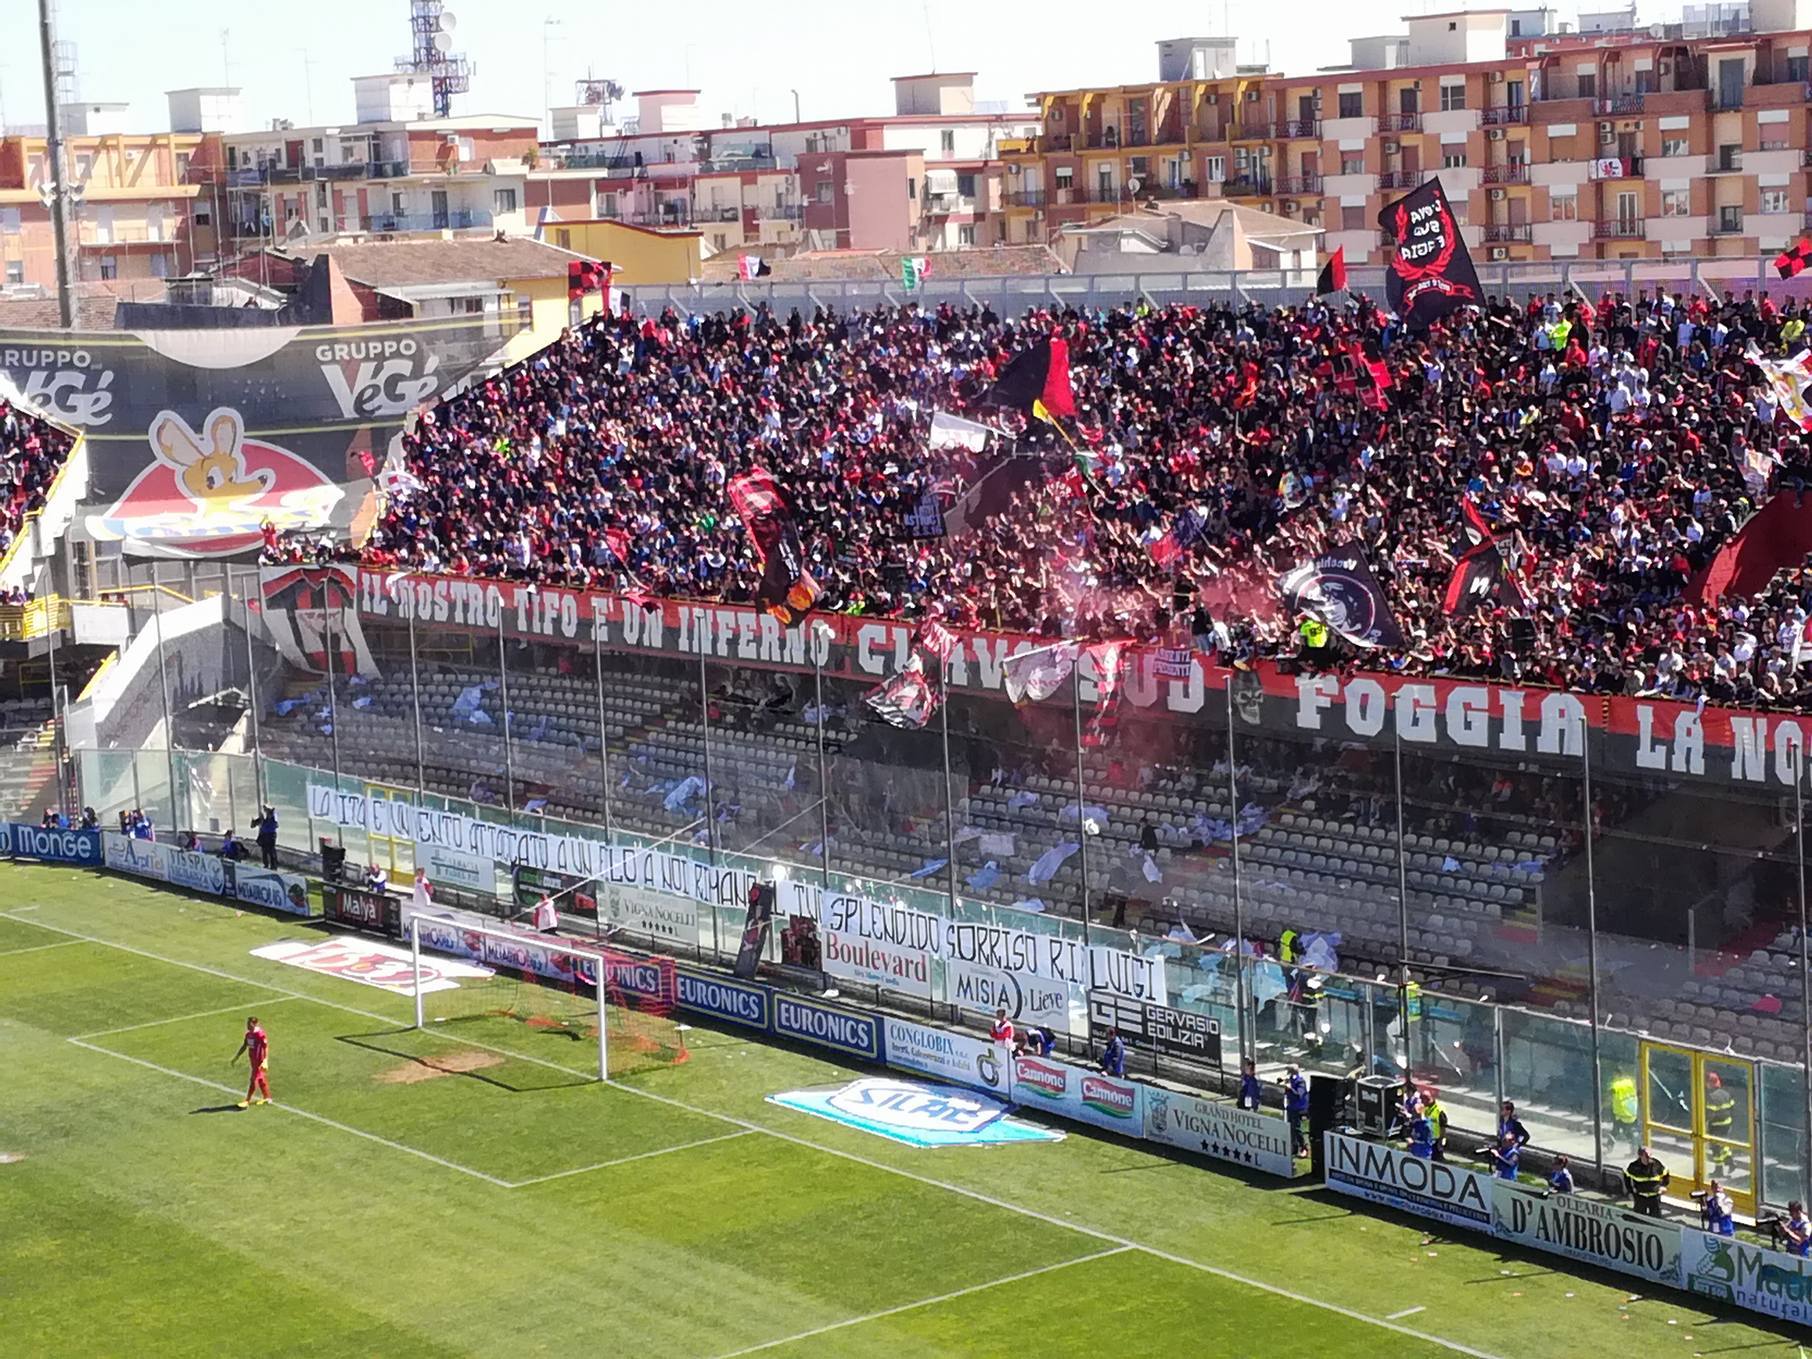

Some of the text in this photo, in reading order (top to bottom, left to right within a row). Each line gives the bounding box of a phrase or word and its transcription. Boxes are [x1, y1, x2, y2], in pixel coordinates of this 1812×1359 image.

[0, 349, 91, 369] RUPPO
[316, 339, 417, 361] GRUPPO
[320, 355, 440, 419] VeGé
[362, 573, 388, 616] IL
[398, 580, 500, 627] NOSTRO
[513, 588, 578, 638] TIFO
[622, 600, 663, 648] UN
[678, 605, 829, 666] INFERNO
[1295, 673, 1584, 756] FOGGIA
[1636, 704, 1705, 775] LA
[1731, 716, 1812, 786] NO
[337, 794, 367, 828] ITA
[416, 811, 463, 848] ENTO
[829, 897, 941, 954] SPLENDIDO
[946, 924, 1039, 974] SORRISO
[1049, 938, 1086, 985] R.I.
[1089, 948, 1157, 1001] LUIGI
[582, 960, 656, 992] EUONICS
[826, 931, 927, 982] Boulevard
[676, 976, 760, 1019] EURONICS
[956, 973, 1012, 1010] MISIA
[780, 1002, 869, 1048] EURONICS
[890, 1024, 954, 1055] CONGLOBIX
[1146, 1004, 1219, 1035] GERVASIO
[1147, 1021, 1205, 1049] EDILIZIA
[1173, 1108, 1287, 1157] VIGNA NOCELLI
[1195, 1102, 1263, 1130] GRAND HOTEL
[1330, 1134, 1487, 1211] INMODA
[1556, 1196, 1613, 1219] OLEARIA
[1511, 1197, 1664, 1272] D'AMBROSIO
